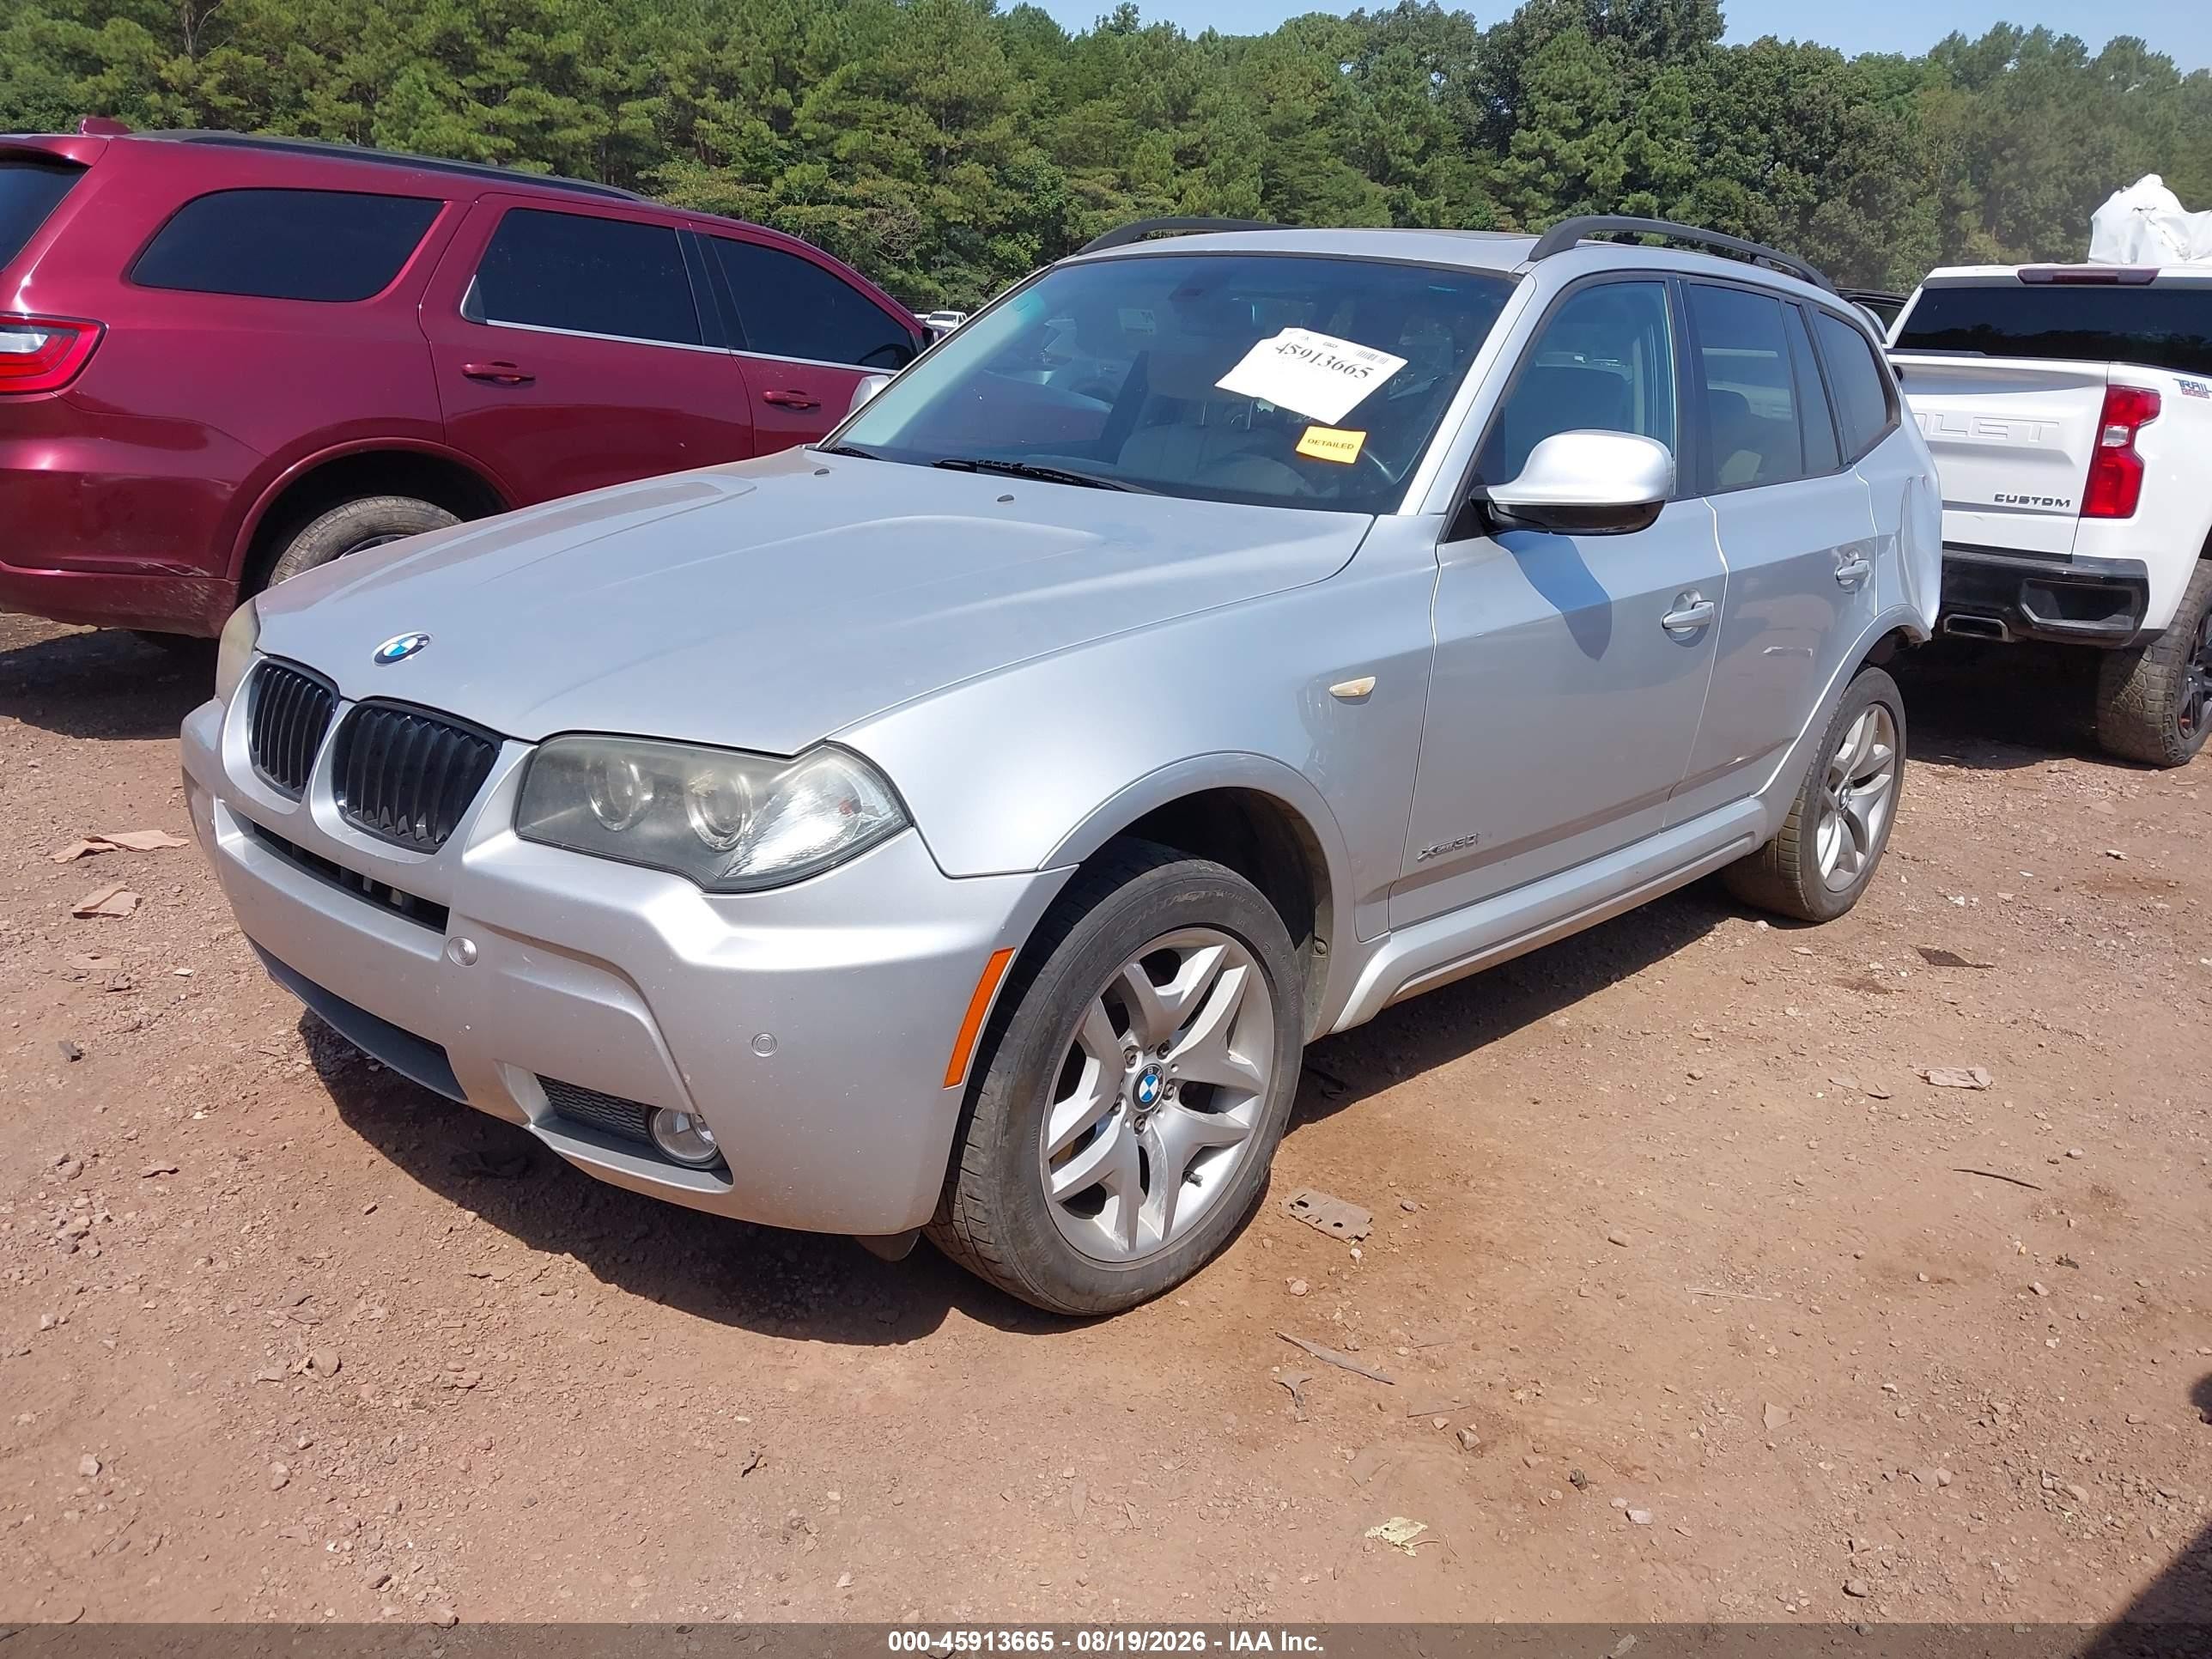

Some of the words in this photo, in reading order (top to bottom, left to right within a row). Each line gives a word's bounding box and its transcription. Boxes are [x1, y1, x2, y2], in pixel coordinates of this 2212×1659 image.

[1275, 342, 1374, 379] 45913665
[2172, 378, 2212, 393] TRAIL
[1307, 438, 1355, 450] DETAILED
[1994, 493, 2070, 507] CUSTOM
